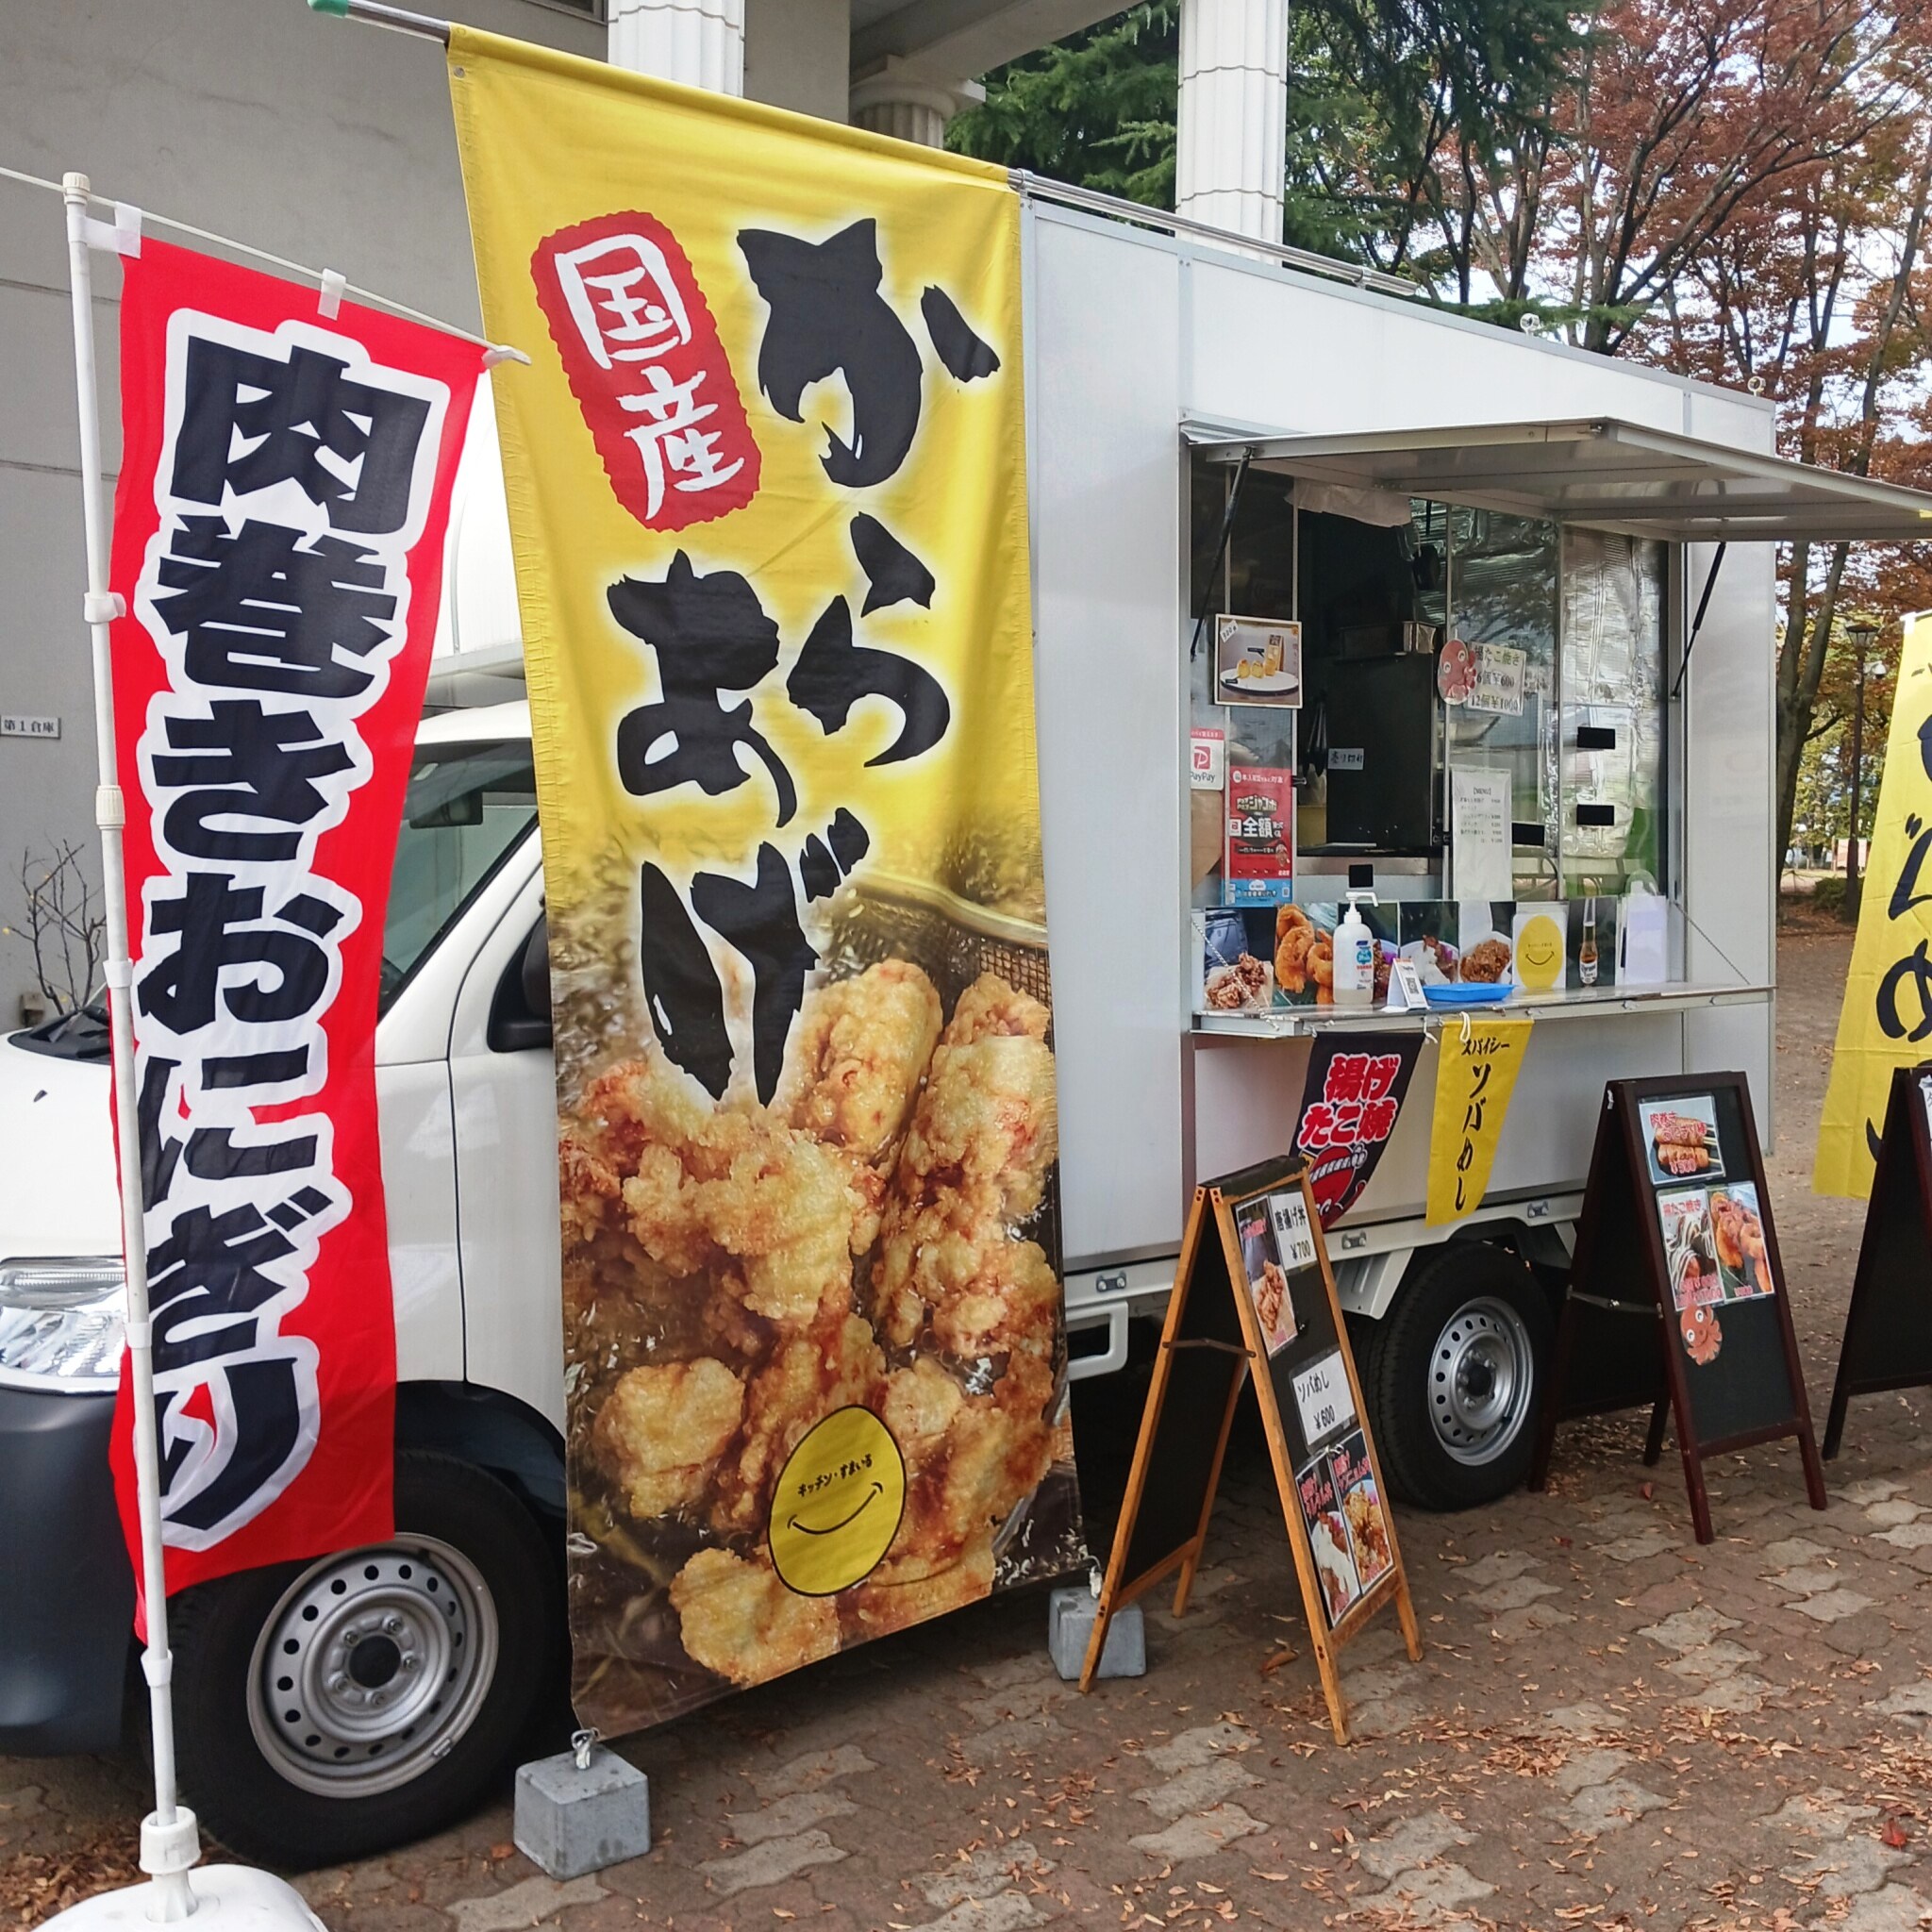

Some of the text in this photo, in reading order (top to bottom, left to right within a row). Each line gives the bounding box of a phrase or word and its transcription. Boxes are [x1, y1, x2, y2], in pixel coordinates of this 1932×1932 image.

[555, 233, 747, 521] 国産
[606, 217, 1001, 1109] からあげ
[138, 332, 434, 1532] 肉巻きおにぎり
[1461, 1037, 1510, 1056] スパイシー
[1324, 1054, 1401, 1103] 揚げ
[1298, 1098, 1398, 1148] たこ焼
[1455, 1063, 1491, 1211] ソバめし
[1290, 1240, 1311, 1260] ¥700
[1298, 1371, 1330, 1403] ソバめし
[1313, 1405, 1336, 1430] ¥600
